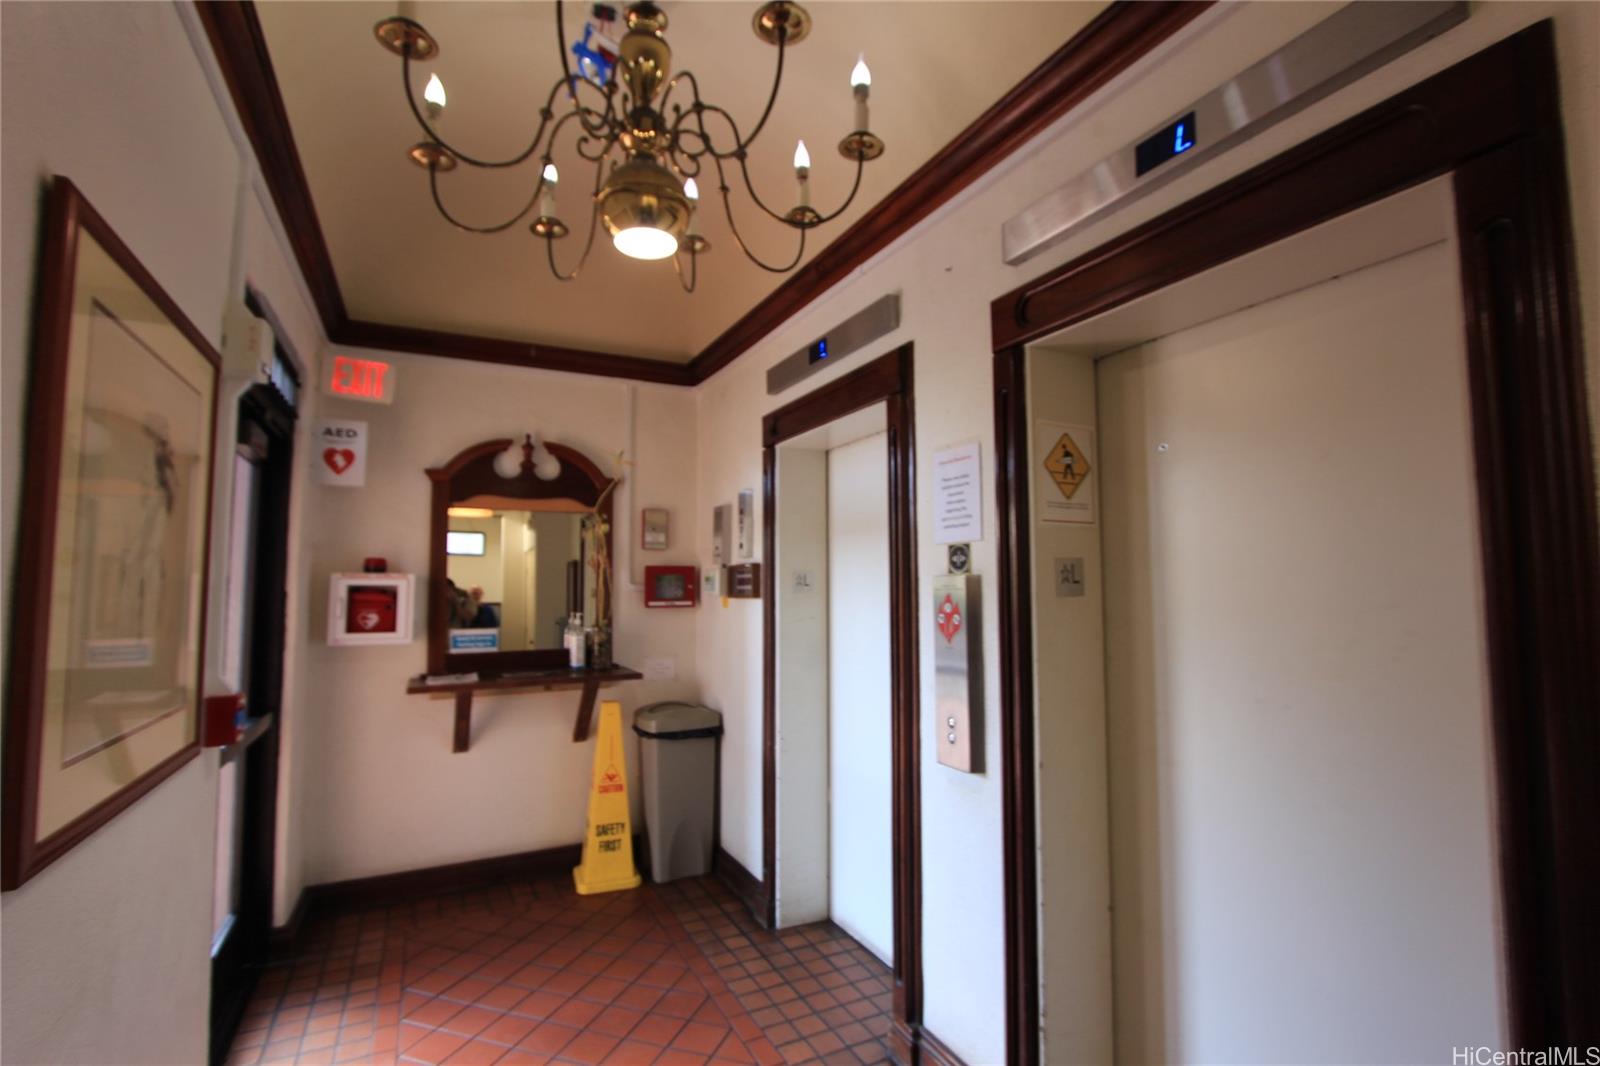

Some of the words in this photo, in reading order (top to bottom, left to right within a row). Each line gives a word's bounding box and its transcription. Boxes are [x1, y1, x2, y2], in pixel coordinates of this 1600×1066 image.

[1174, 124, 1192, 152] L
[332, 356, 389, 399] EXIT
[322, 427, 358, 438] AED
[596, 822, 625, 837] SAFETY
[598, 839, 621, 853] FIRST
